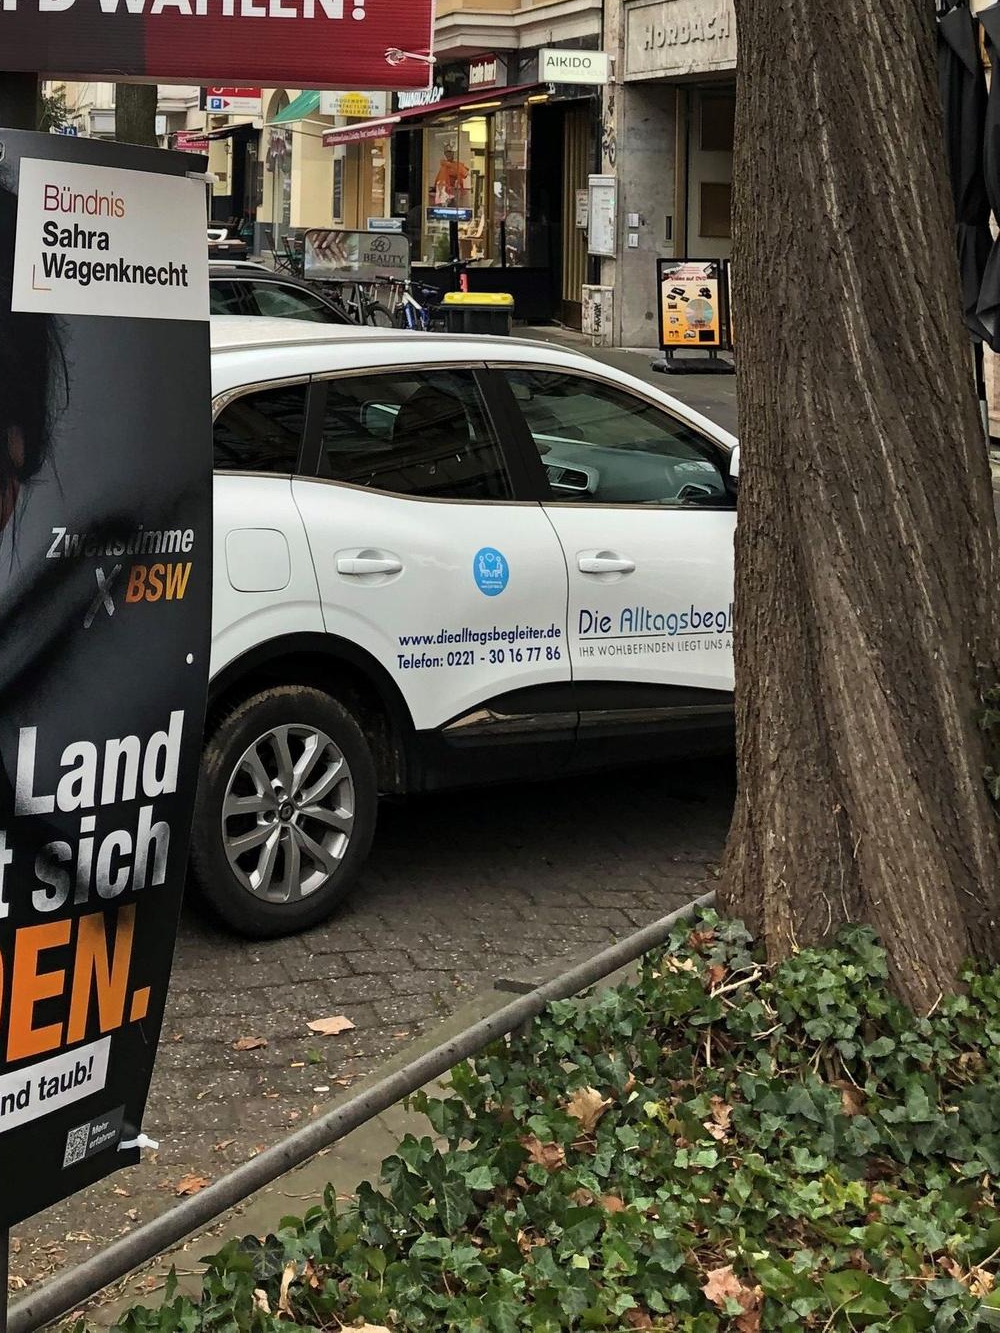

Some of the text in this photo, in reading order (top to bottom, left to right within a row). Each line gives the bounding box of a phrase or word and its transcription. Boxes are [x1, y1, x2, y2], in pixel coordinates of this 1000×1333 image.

[643, 12, 731, 51] HORBACH
[546, 56, 592, 69] AIKIDO
[213, 99, 220, 108] P
[43, 184, 125, 218] Bündnis
[42, 220, 110, 251] Sahra
[42, 252, 189, 287] Wagenknecht
[363, 253, 404, 264] BEAUTY
[125, 562, 193, 603] BSW
[399, 623, 562, 646] www.diealltagsbegleiter.de
[579, 609, 612, 635] Die
[397, 652, 444, 669] Telefon:
[447, 650, 475, 666] 0221
[489, 649, 505, 663] 30
[509, 648, 523, 662] 16
[527, 647, 541, 662] 77
[546, 646, 561, 660] 86
[579, 646, 595, 657] IHR
[598, 641, 675, 656] WOHLBEFINDEN
[678, 640, 701, 652] LIEGT
[704, 638, 723, 651] UNS
[14, 709, 185, 816] Land
[31, 805, 170, 914] sich
[37, 1056, 94, 1101] taub!
